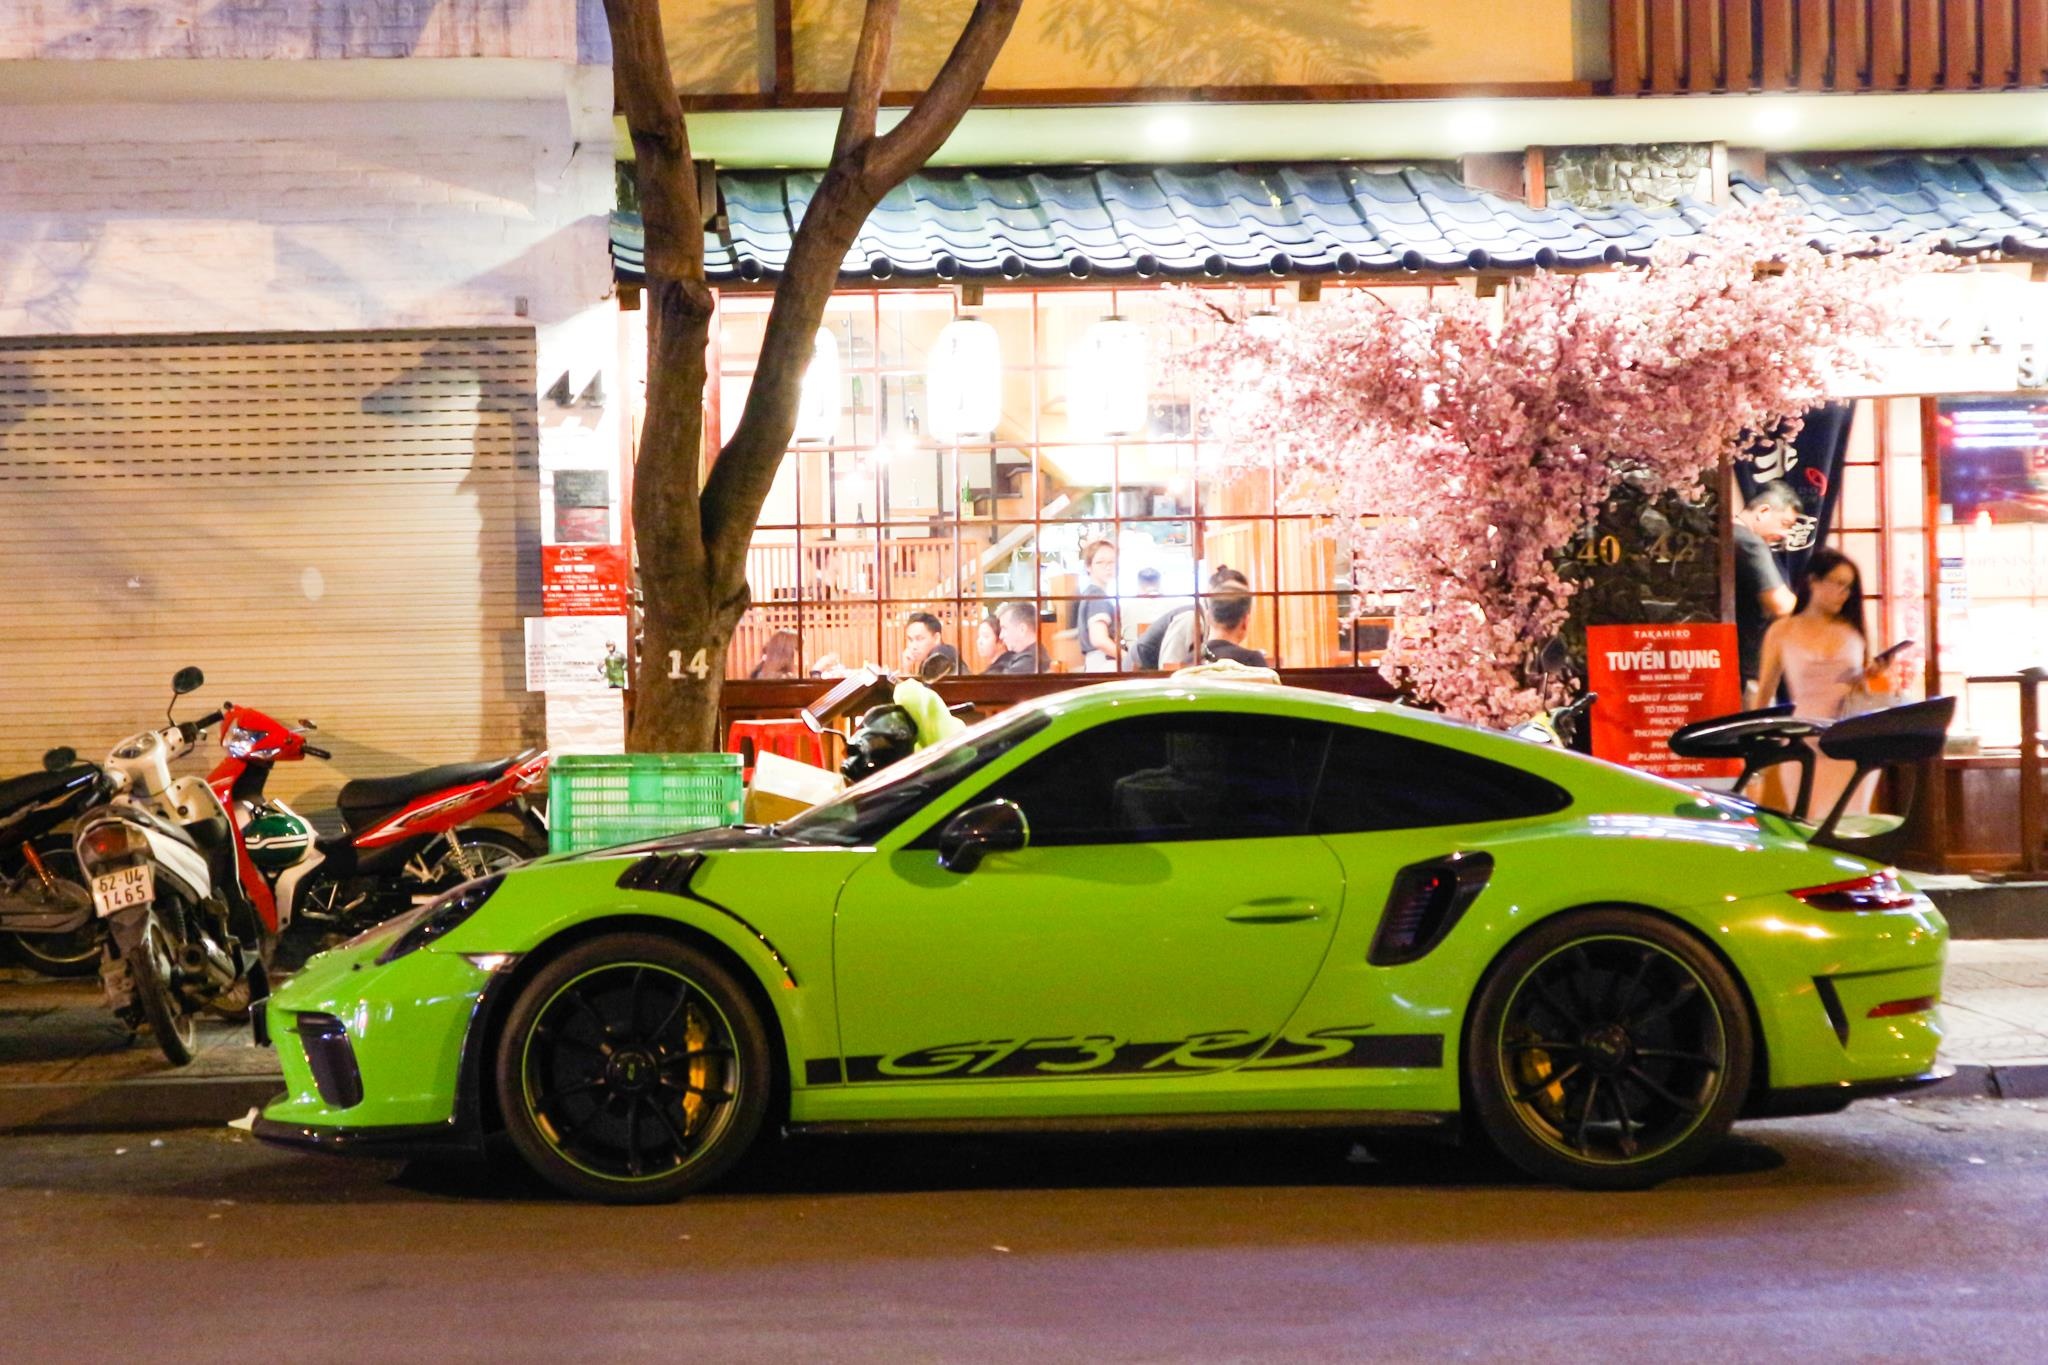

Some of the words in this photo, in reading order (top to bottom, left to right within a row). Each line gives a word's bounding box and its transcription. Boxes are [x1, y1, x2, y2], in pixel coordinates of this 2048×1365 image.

[1633, 629, 1691, 640] TAKAHIRO
[668, 648, 710, 680] 14
[1605, 642, 1665, 671] TUYỂN
[1669, 649, 1721, 673] DỤNG
[103, 884, 146, 911] 1465
[877, 1035, 1118, 1075] GT3
[1142, 1023, 1375, 1068] RS
